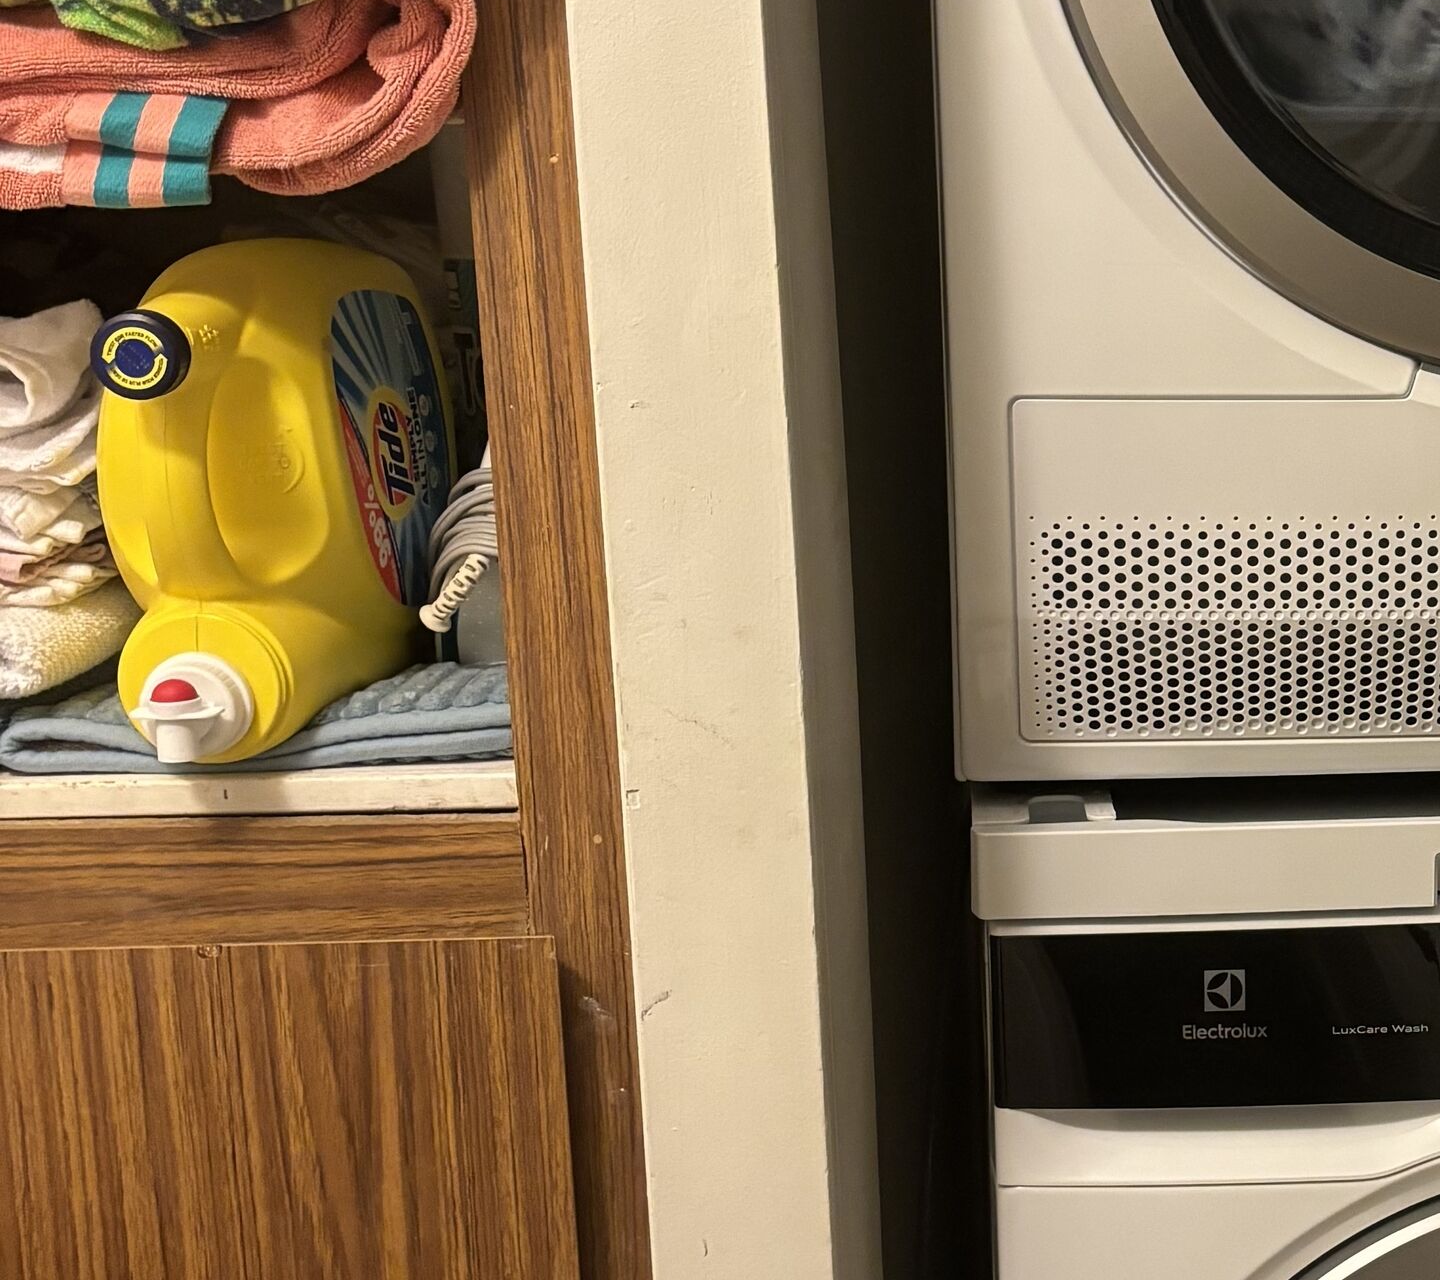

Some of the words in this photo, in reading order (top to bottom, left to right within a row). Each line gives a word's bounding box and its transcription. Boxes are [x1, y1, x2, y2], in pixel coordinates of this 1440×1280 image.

[378, 401, 416, 507] Tide
[406, 415, 420, 482] SIMPLY
[363, 483, 392, 568] 99%
[1182, 1023, 1268, 1041] Electrolux
[1332, 1024, 1388, 1036] LuxCare
[1392, 1023, 1429, 1034] Wash
